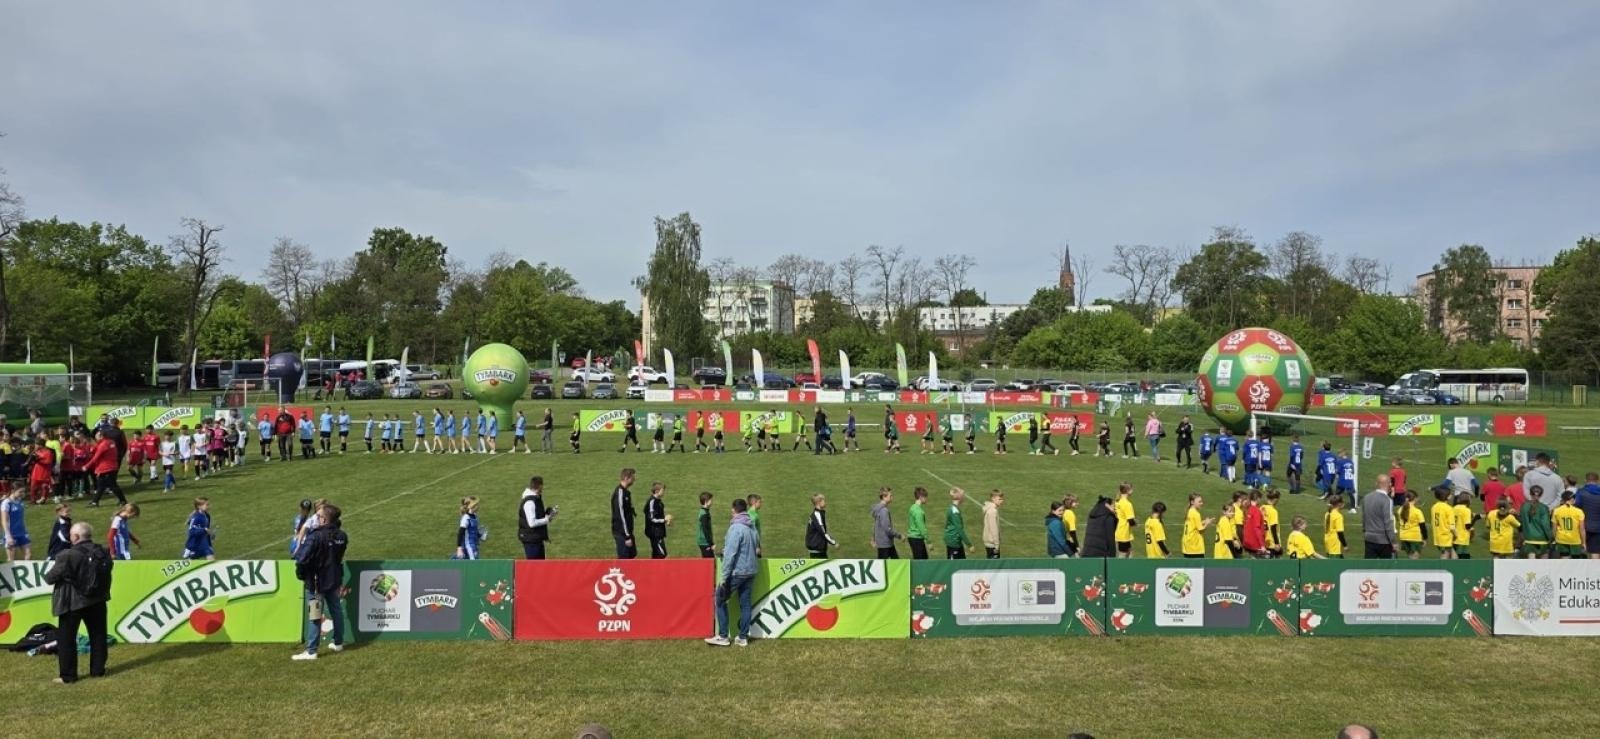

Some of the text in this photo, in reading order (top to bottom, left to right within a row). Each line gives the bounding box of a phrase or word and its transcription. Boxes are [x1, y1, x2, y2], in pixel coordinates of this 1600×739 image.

[1457, 442, 1488, 464] YMBARK
[1561, 517, 1573, 531] 10
[1559, 577, 1600, 591] Minist
[127, 560, 269, 640] TYMBARK
[750, 559, 879, 636] TYMBARK
[1559, 595, 1600, 609] Eduka
[598, 619, 631, 632] PZPN
